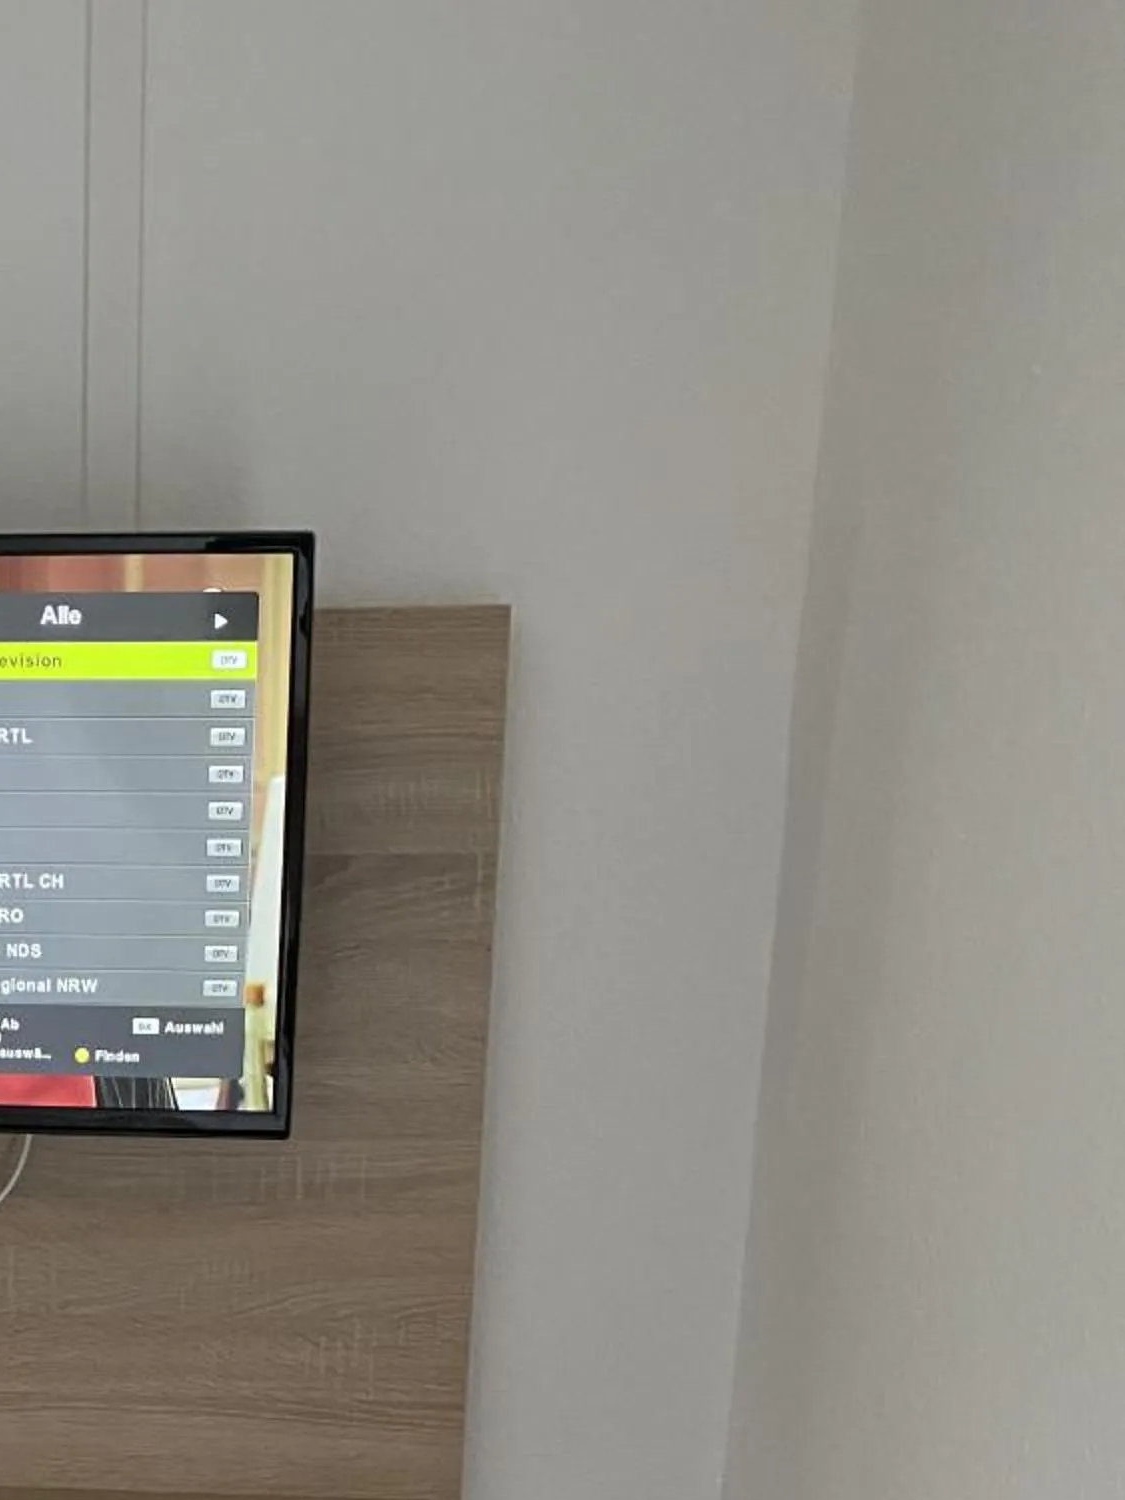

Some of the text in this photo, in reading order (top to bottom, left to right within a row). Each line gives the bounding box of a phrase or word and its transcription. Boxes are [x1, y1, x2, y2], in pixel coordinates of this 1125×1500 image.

[40, 605, 82, 625] Alle
[39, 874, 64, 889] CH
[6, 943, 42, 958] NDS
[57, 978, 98, 993] NRW
[164, 1021, 224, 1034] Auswahl
[95, 1050, 140, 1063] Finden
